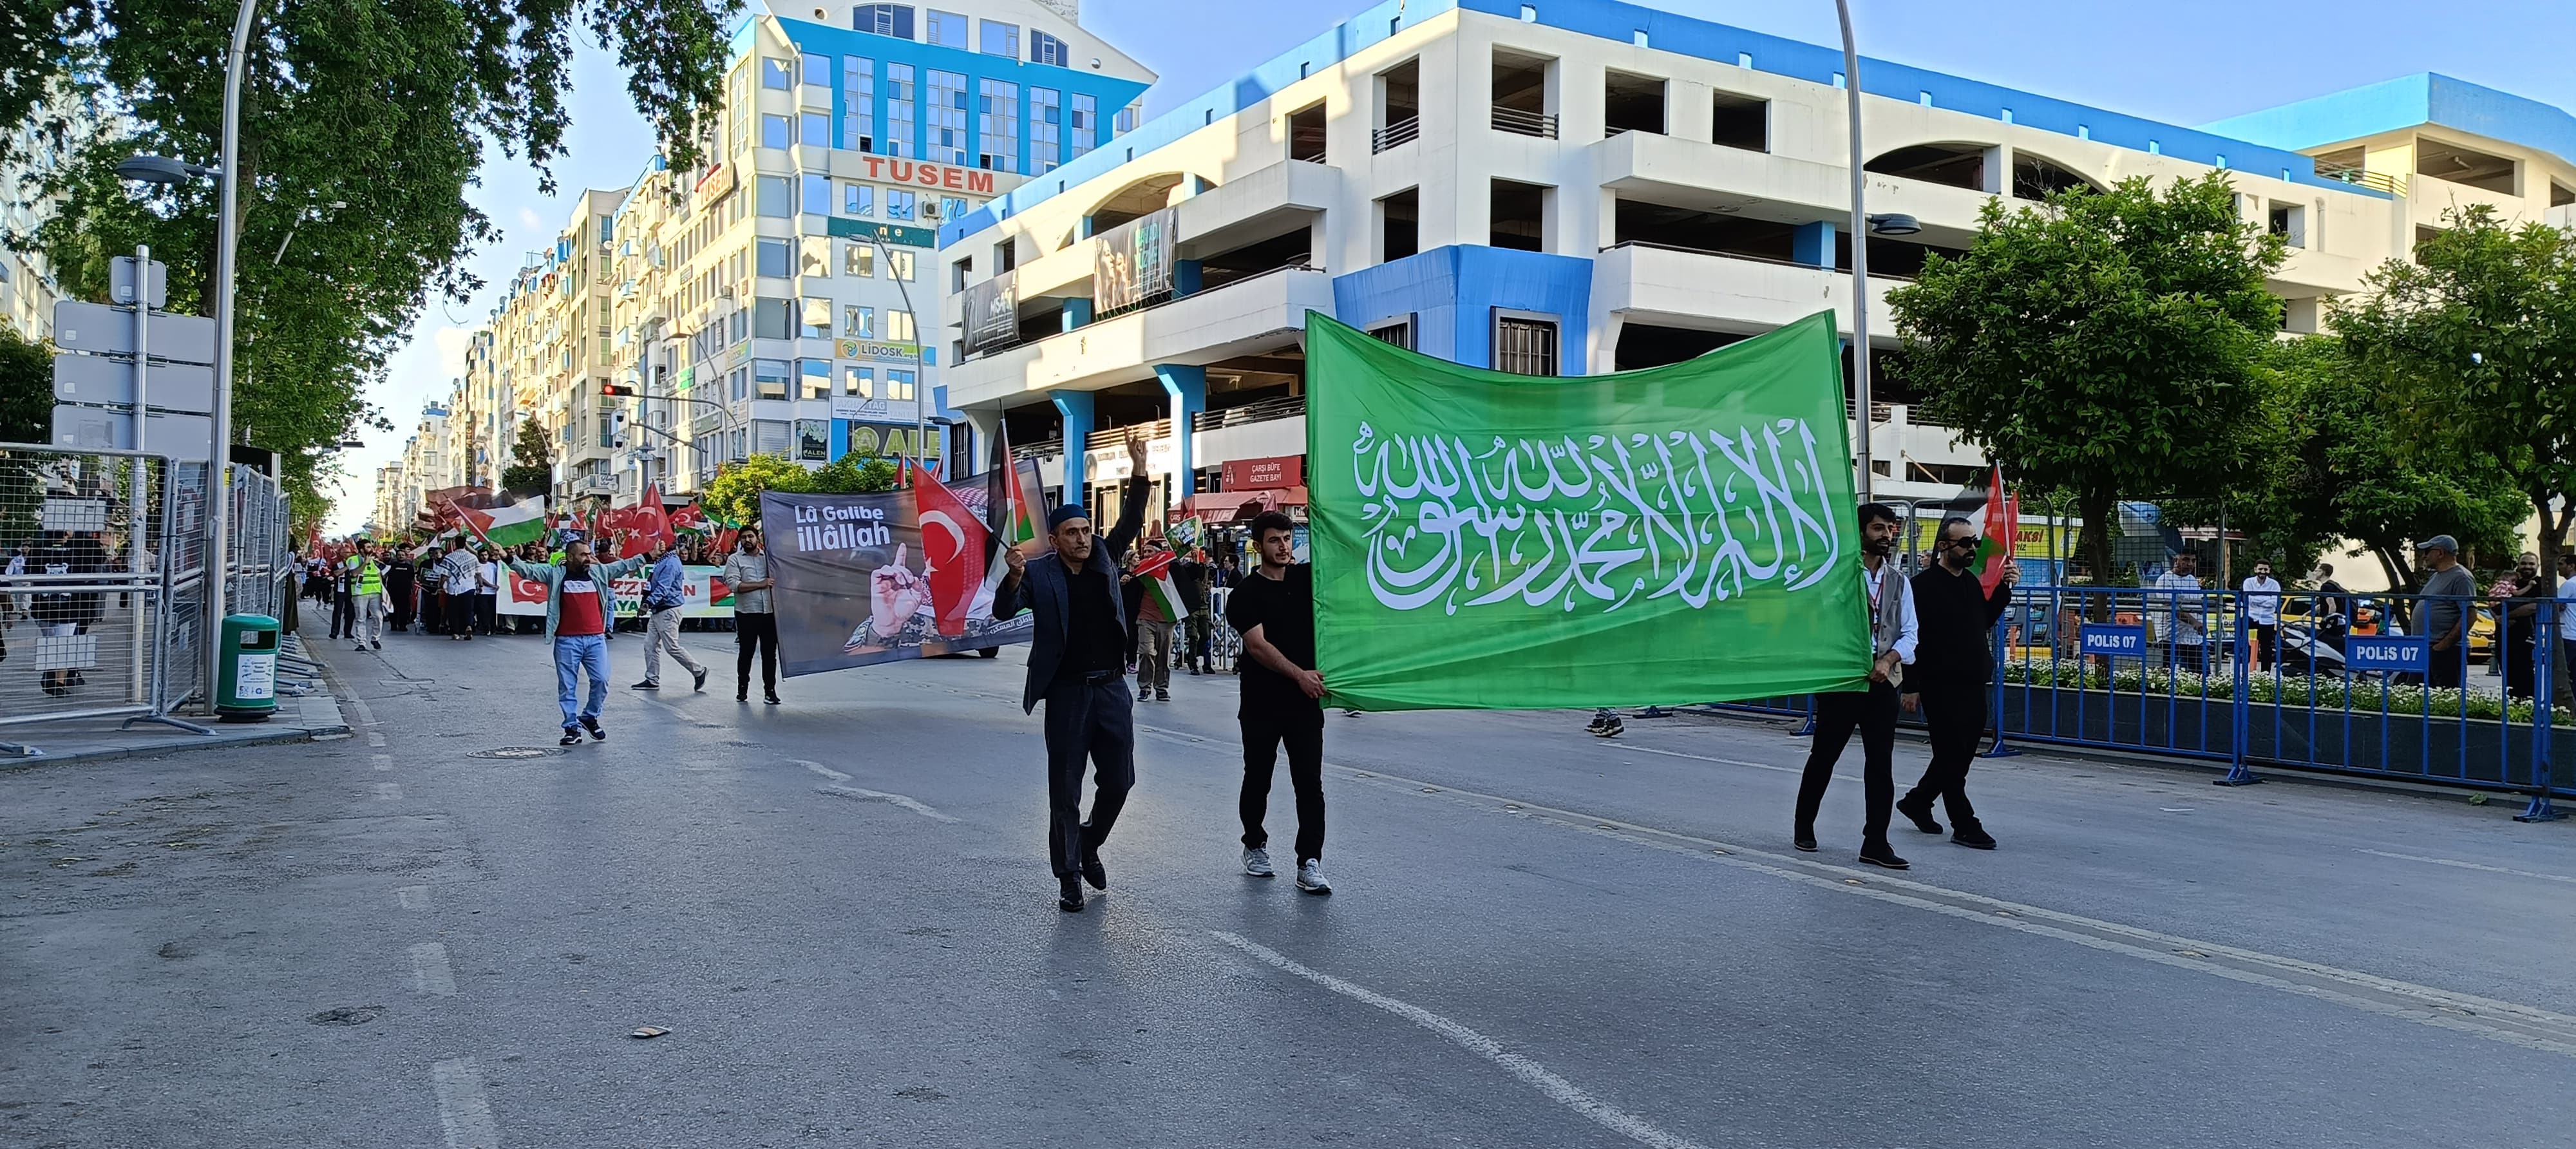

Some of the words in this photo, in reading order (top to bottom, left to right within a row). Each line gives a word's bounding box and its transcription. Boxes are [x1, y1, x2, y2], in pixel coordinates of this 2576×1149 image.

[863, 157, 993, 193] TUSEM
[882, 428, 940, 459] ALE
[1267, 462, 1281, 471] BÜFE
[795, 505, 818, 524] Lâ
[822, 506, 884, 521] Galibe
[797, 520, 891, 552] illâllah
[2123, 636, 2137, 649] 07
[2401, 647, 2419, 661] 07
